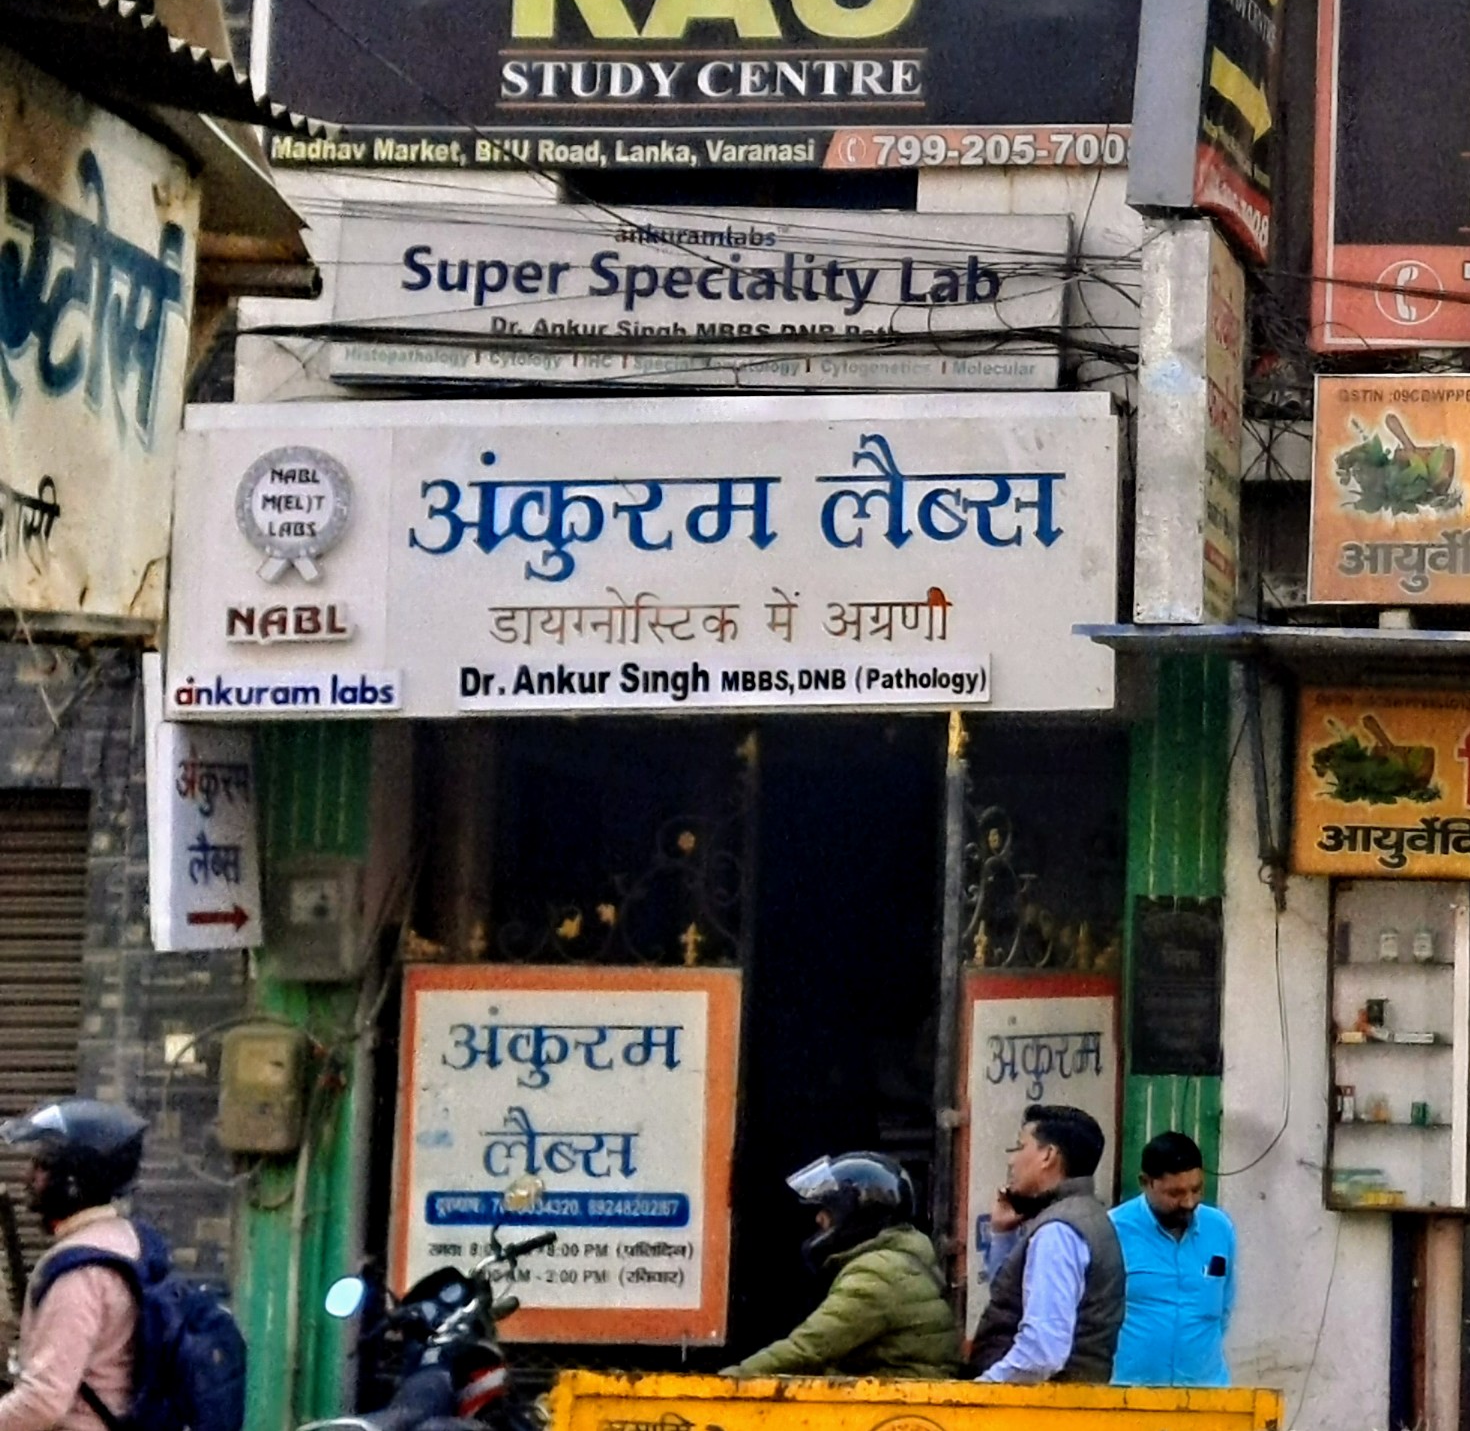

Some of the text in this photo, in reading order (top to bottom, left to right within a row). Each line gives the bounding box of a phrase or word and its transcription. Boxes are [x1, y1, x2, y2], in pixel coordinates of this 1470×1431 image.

[501, 60, 922, 99] STUDY CENTRE
[271, 139, 365, 162] Madhav
[374, 138, 466, 164] Market,
[538, 140, 606, 166] Road,
[615, 139, 697, 166] Lanka,
[705, 139, 815, 162] Varanasi
[873, 133, 1130, 166] 799-205-700
[402, 245, 1000, 316] Super Speciality Lab
[270, 469, 320, 485] NABL
[268, 520, 317, 537] LABS
[409, 451, 781, 582] अंकुरम
[815, 434, 1066, 550] लैब्स
[226, 605, 349, 638] NABL
[489, 587, 953, 645] डायग्नोस्टिक में अग्रणी
[174, 675, 394, 707] ankuram labs
[460, 667, 506, 697] Dr.
[513, 664, 609, 695] Ankur
[620, 661, 710, 701] Singh
[856, 665, 987, 705] (Pathology)
[443, 1006, 684, 1089] अंकुरम
[985, 1015, 1104, 1100] अंकुरम
[479, 1106, 639, 1179] लैब्स
